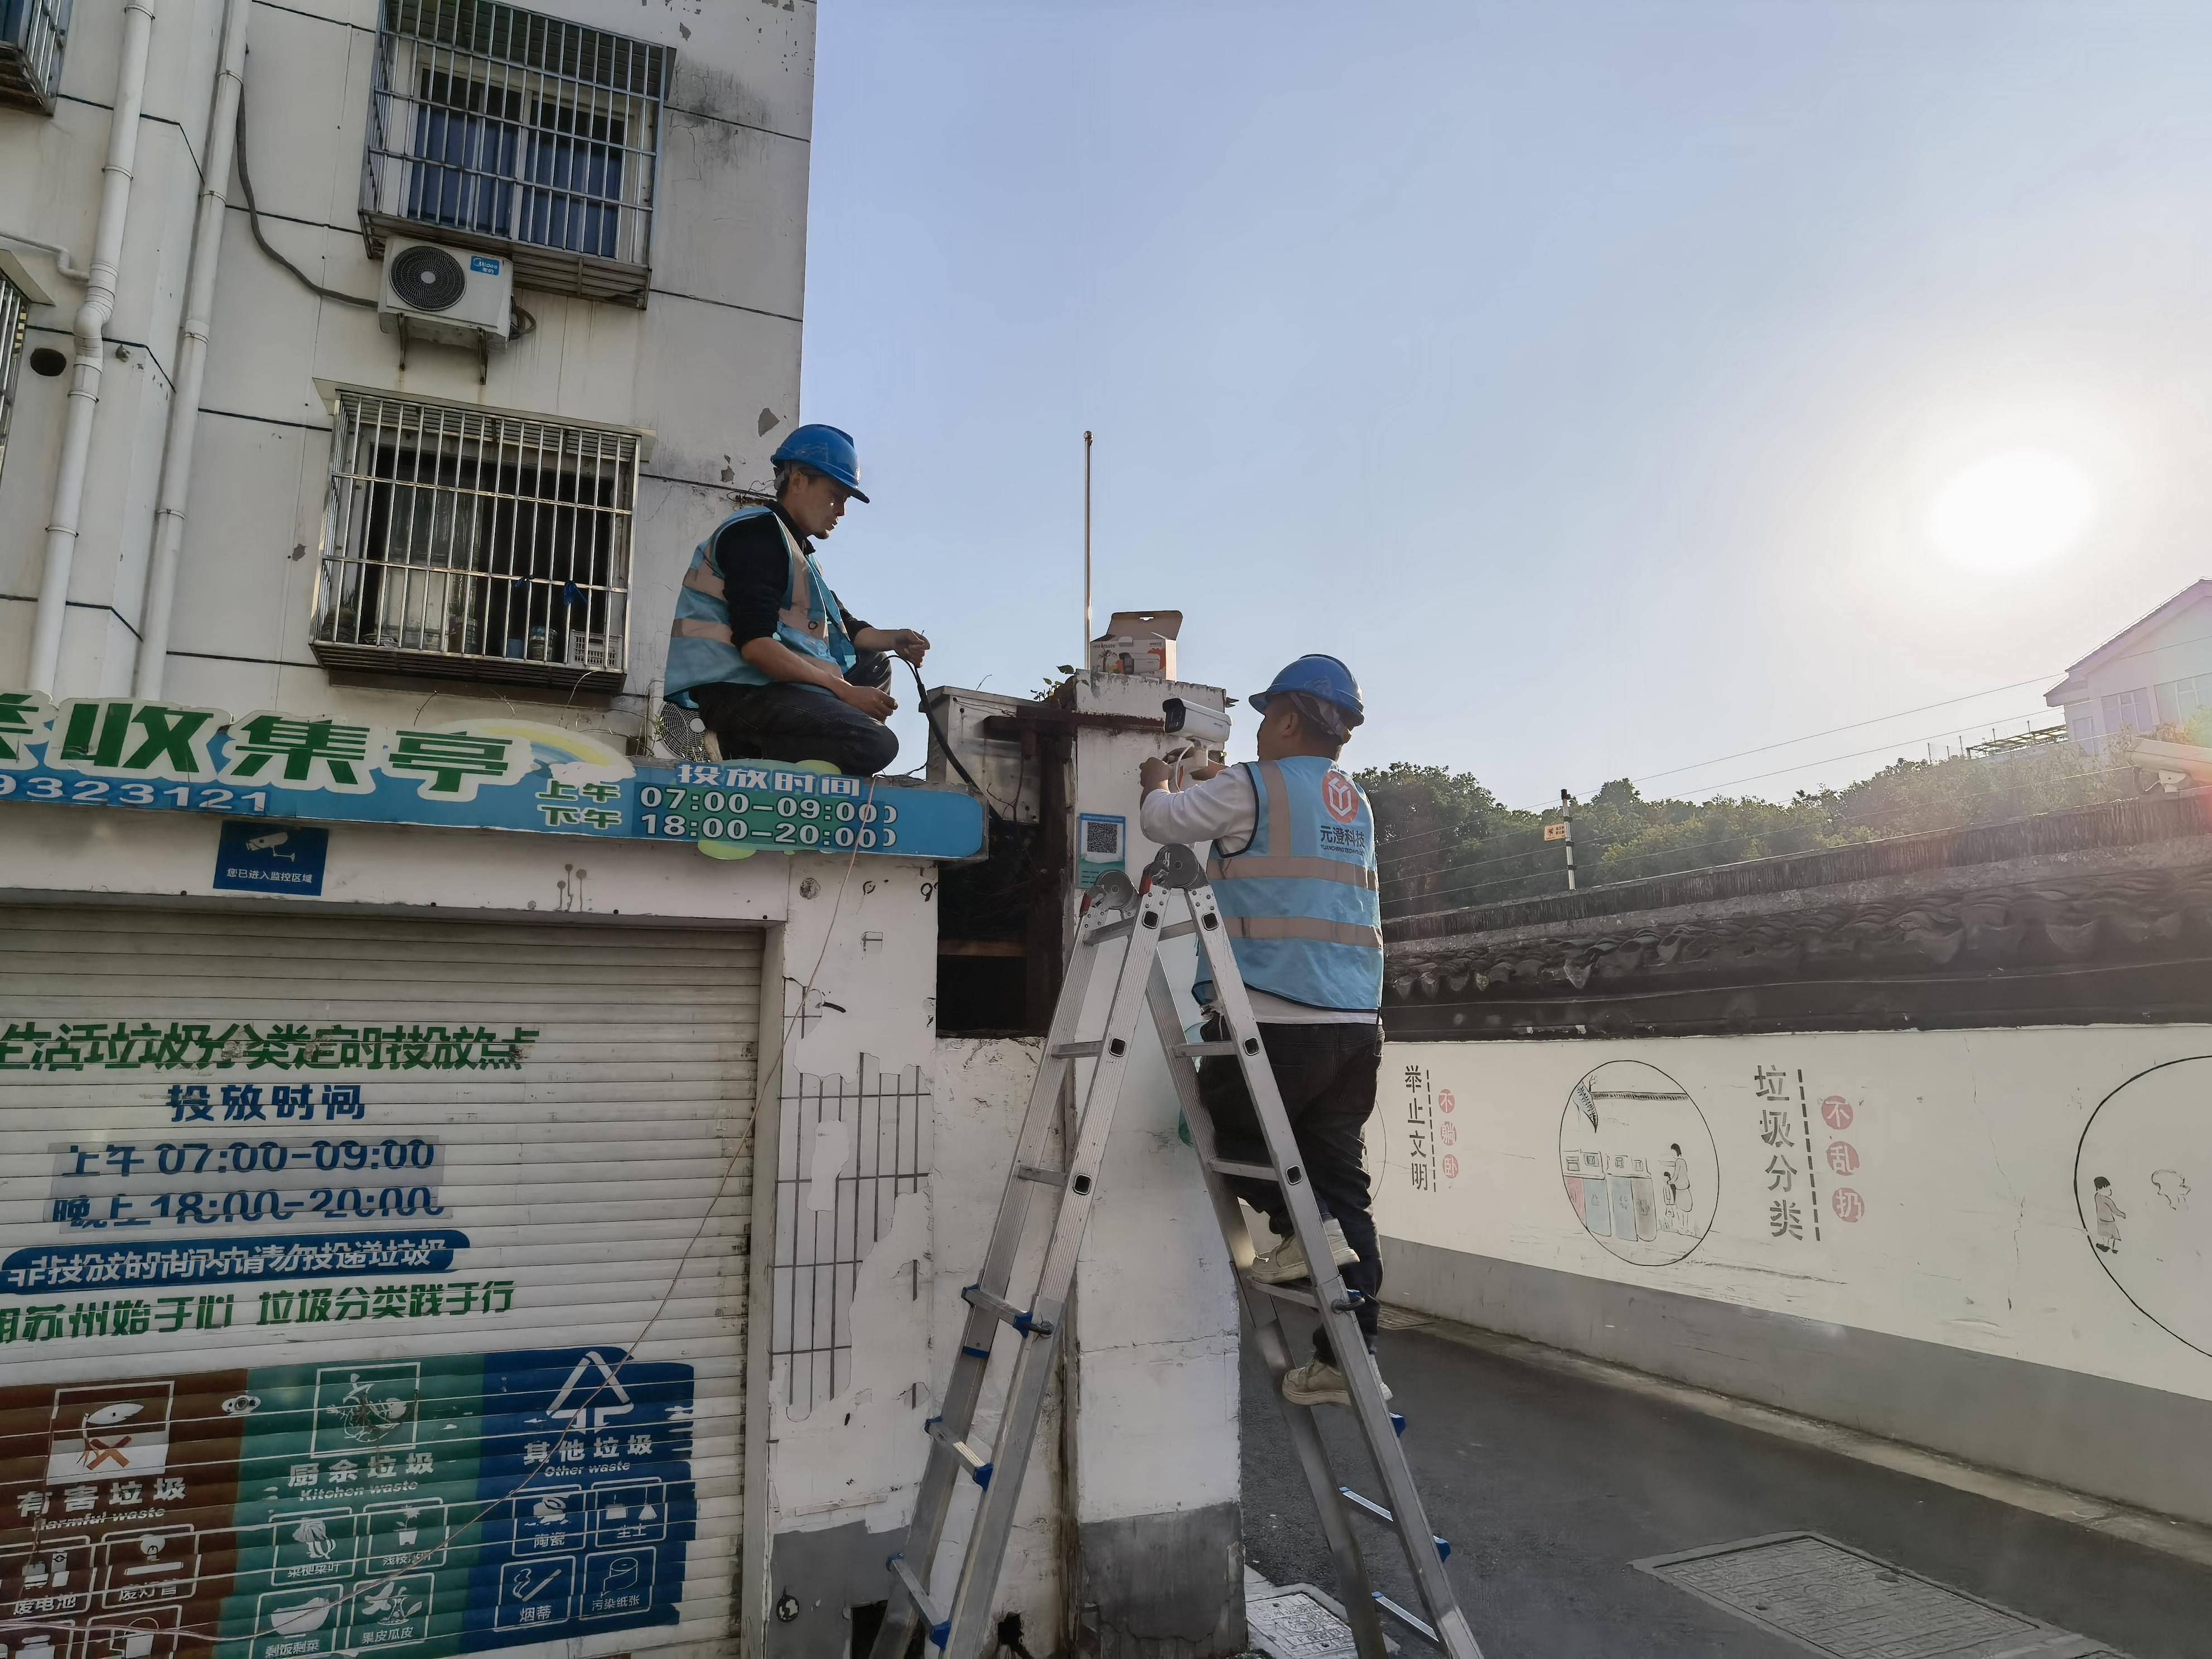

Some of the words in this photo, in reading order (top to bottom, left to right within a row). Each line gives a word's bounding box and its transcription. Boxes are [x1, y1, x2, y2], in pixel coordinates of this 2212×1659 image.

[474, 258, 498, 269] Midea
[0, 692, 513, 792] 收集亭
[535, 779, 620, 803] 上午
[678, 764, 860, 797] 投放时间
[537, 804, 622, 829] 下午
[227, 868, 312, 883] 您已进入监控区域
[0, 1022, 540, 1071] 生活垃圾分类定时投放点
[167, 1083, 365, 1122] 投放时间
[1404, 1065, 1428, 1191] 举止文明
[62, 1145, 144, 1176] 上午
[1754, 1064, 1803, 1241] 垃圾分类
[1823, 1098, 1865, 1222] 不乱扔
[54, 1193, 152, 1228] 晚上
[257, 1281, 515, 1326] 垃圾分类践于行
[523, 1434, 652, 1466] 其他垃圾
[288, 1453, 434, 1487] 厨余垃圾
[544, 1465, 585, 1477] Other
[588, 1460, 631, 1473] waste
[17, 1477, 187, 1517] 有害垃圾
[370, 1480, 419, 1494] waste
[519, 1605, 552, 1622] 烟蒂
[592, 1594, 640, 1611] 污染纸张
[363, 1626, 414, 1644] 果皮瓜皮
